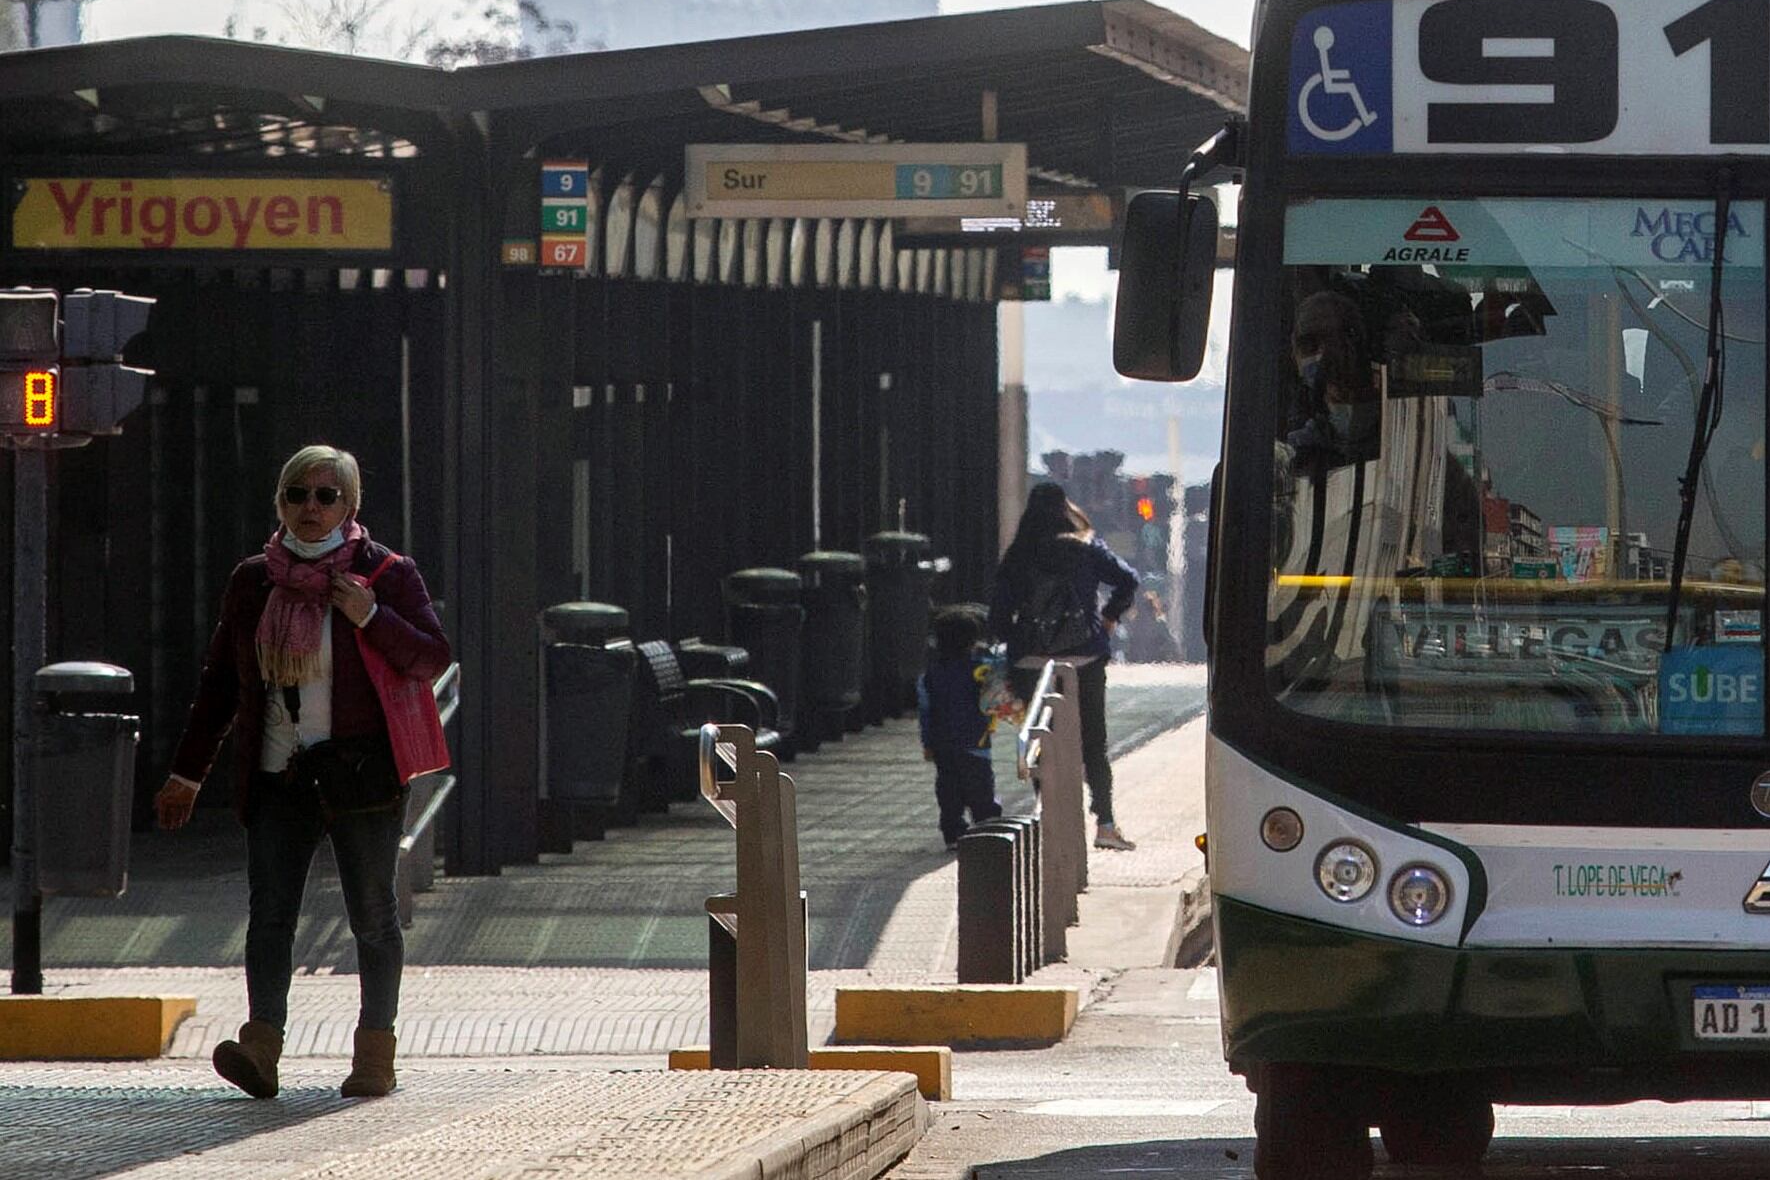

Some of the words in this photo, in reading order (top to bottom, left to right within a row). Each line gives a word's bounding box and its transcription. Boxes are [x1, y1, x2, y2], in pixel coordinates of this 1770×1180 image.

[560, 174, 573, 191] 9
[723, 169, 766, 190] Sur
[913, 171, 931, 196] 9
[960, 169, 992, 196] 91
[48, 181, 344, 248] Yrigoyen
[556, 209, 578, 226] 91
[554, 245, 577, 261] 67
[1384, 247, 1470, 262] AGRALE
[25, 371, 53, 427] 8
[1668, 673, 1758, 704] SUBE
[1568, 865, 1605, 896] LOPE
[1608, 865, 1627, 896] DE
[1630, 865, 1668, 897] VEGA
[1701, 1003, 1739, 1033] AD
